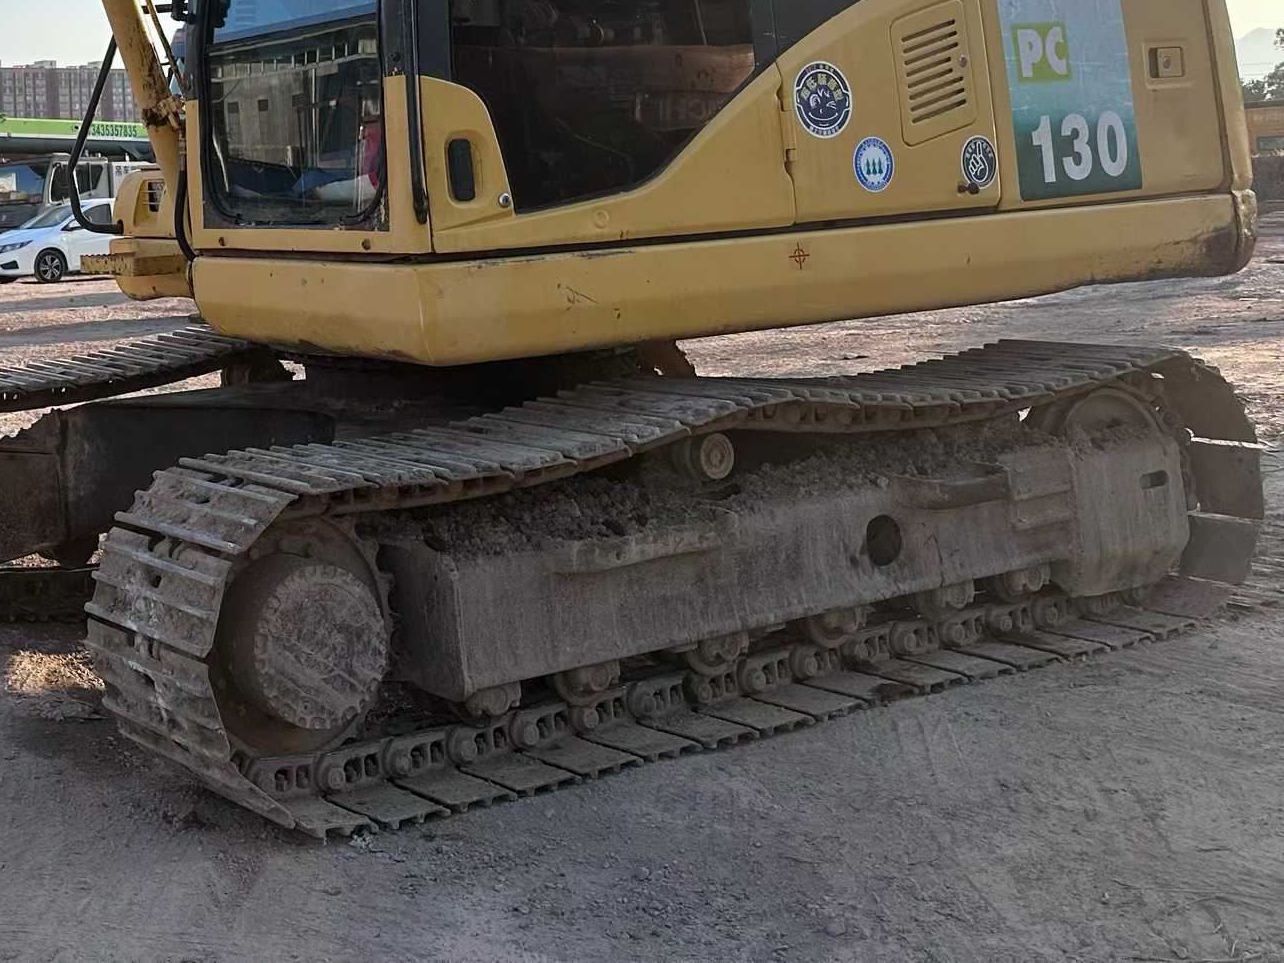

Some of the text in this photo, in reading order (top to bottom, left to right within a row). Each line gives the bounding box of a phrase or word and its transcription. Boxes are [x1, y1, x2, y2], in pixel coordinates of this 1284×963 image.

[1017, 26, 1067, 78] PC
[89, 124, 138, 137] 3435357835
[1031, 110, 1128, 183] 130
